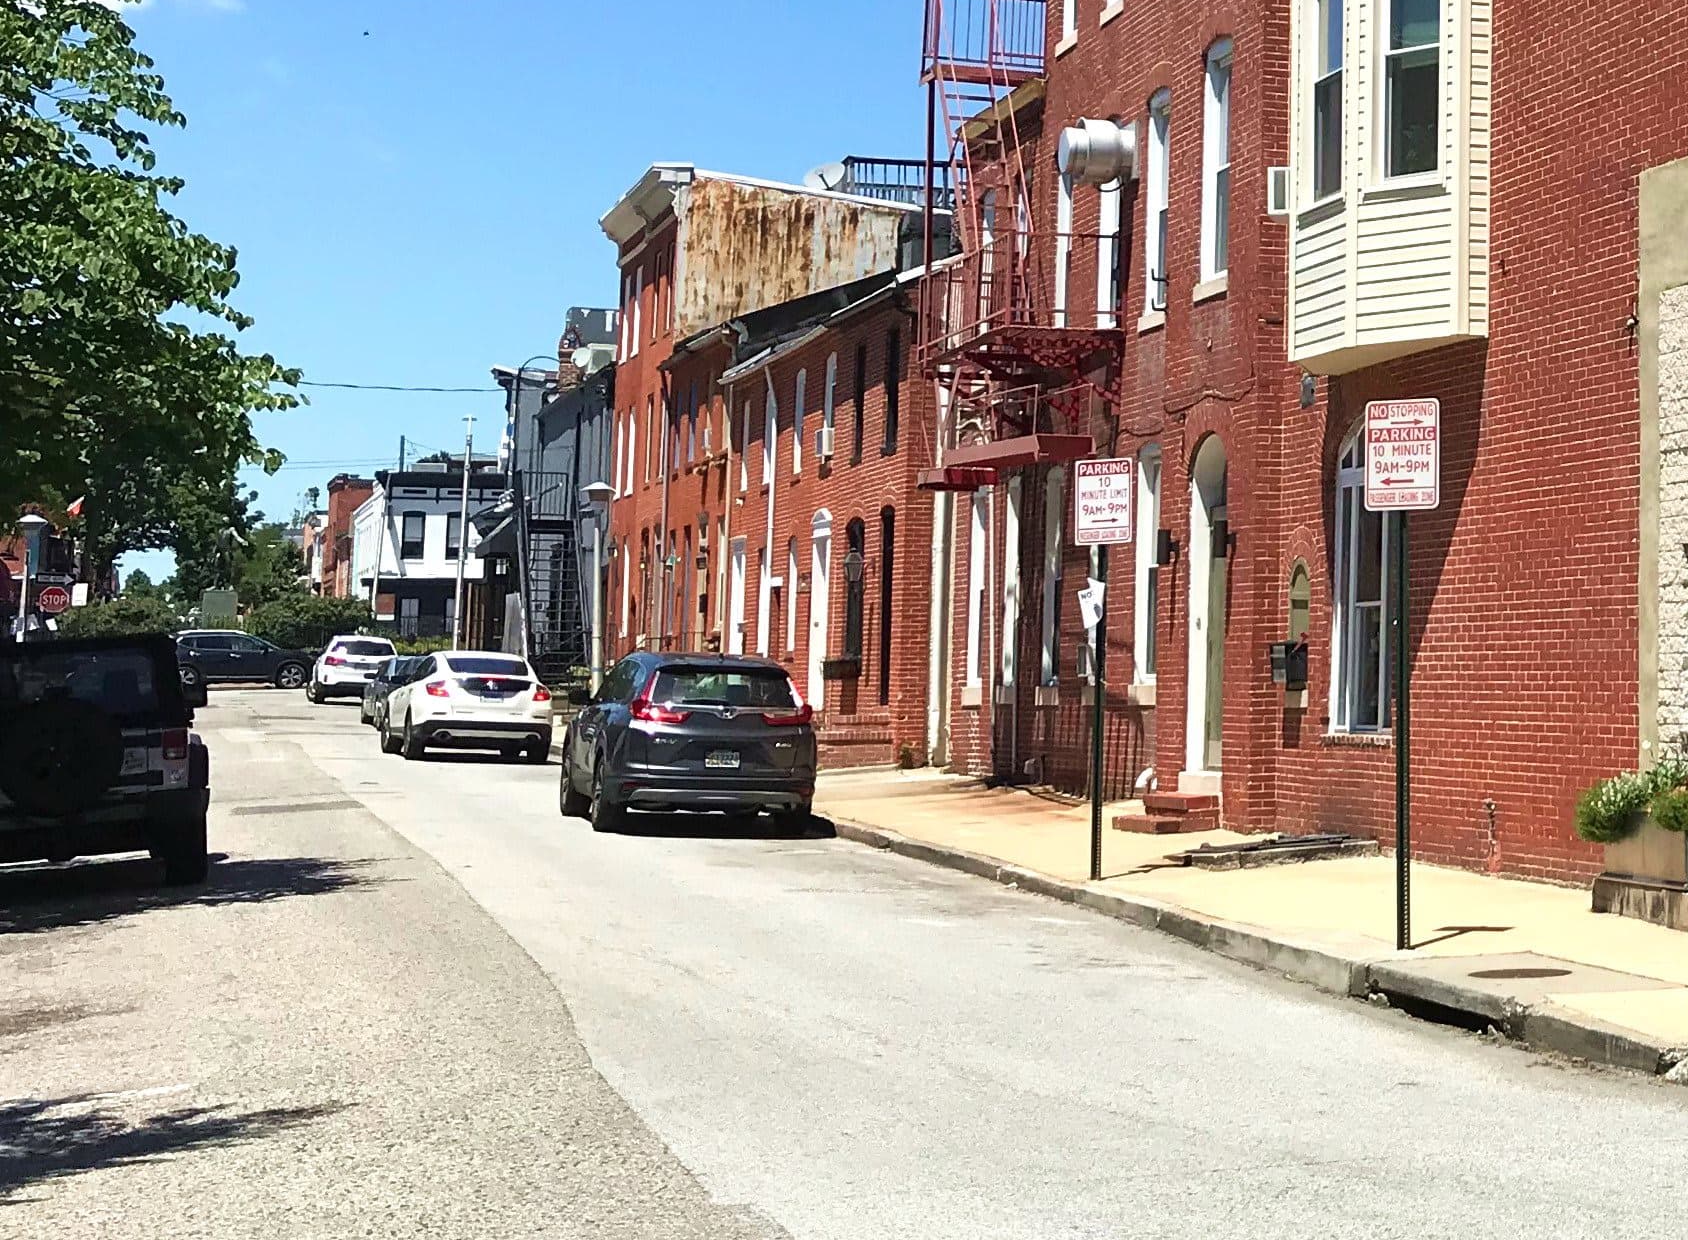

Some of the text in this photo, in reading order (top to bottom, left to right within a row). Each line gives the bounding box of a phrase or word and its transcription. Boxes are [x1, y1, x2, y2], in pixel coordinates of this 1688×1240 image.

[1370, 404, 1434, 418] NO STOPPING
[1371, 427, 1435, 442] PARKING
[1373, 443, 1432, 457] 10 MINUTE
[1079, 462, 1129, 476] PARKING
[1375, 460, 1430, 474] 9AM-9PM
[1098, 476, 1111, 487] 10
[1081, 488, 1128, 501] MINUTE LIMIT
[42, 594, 67, 605] STOP
